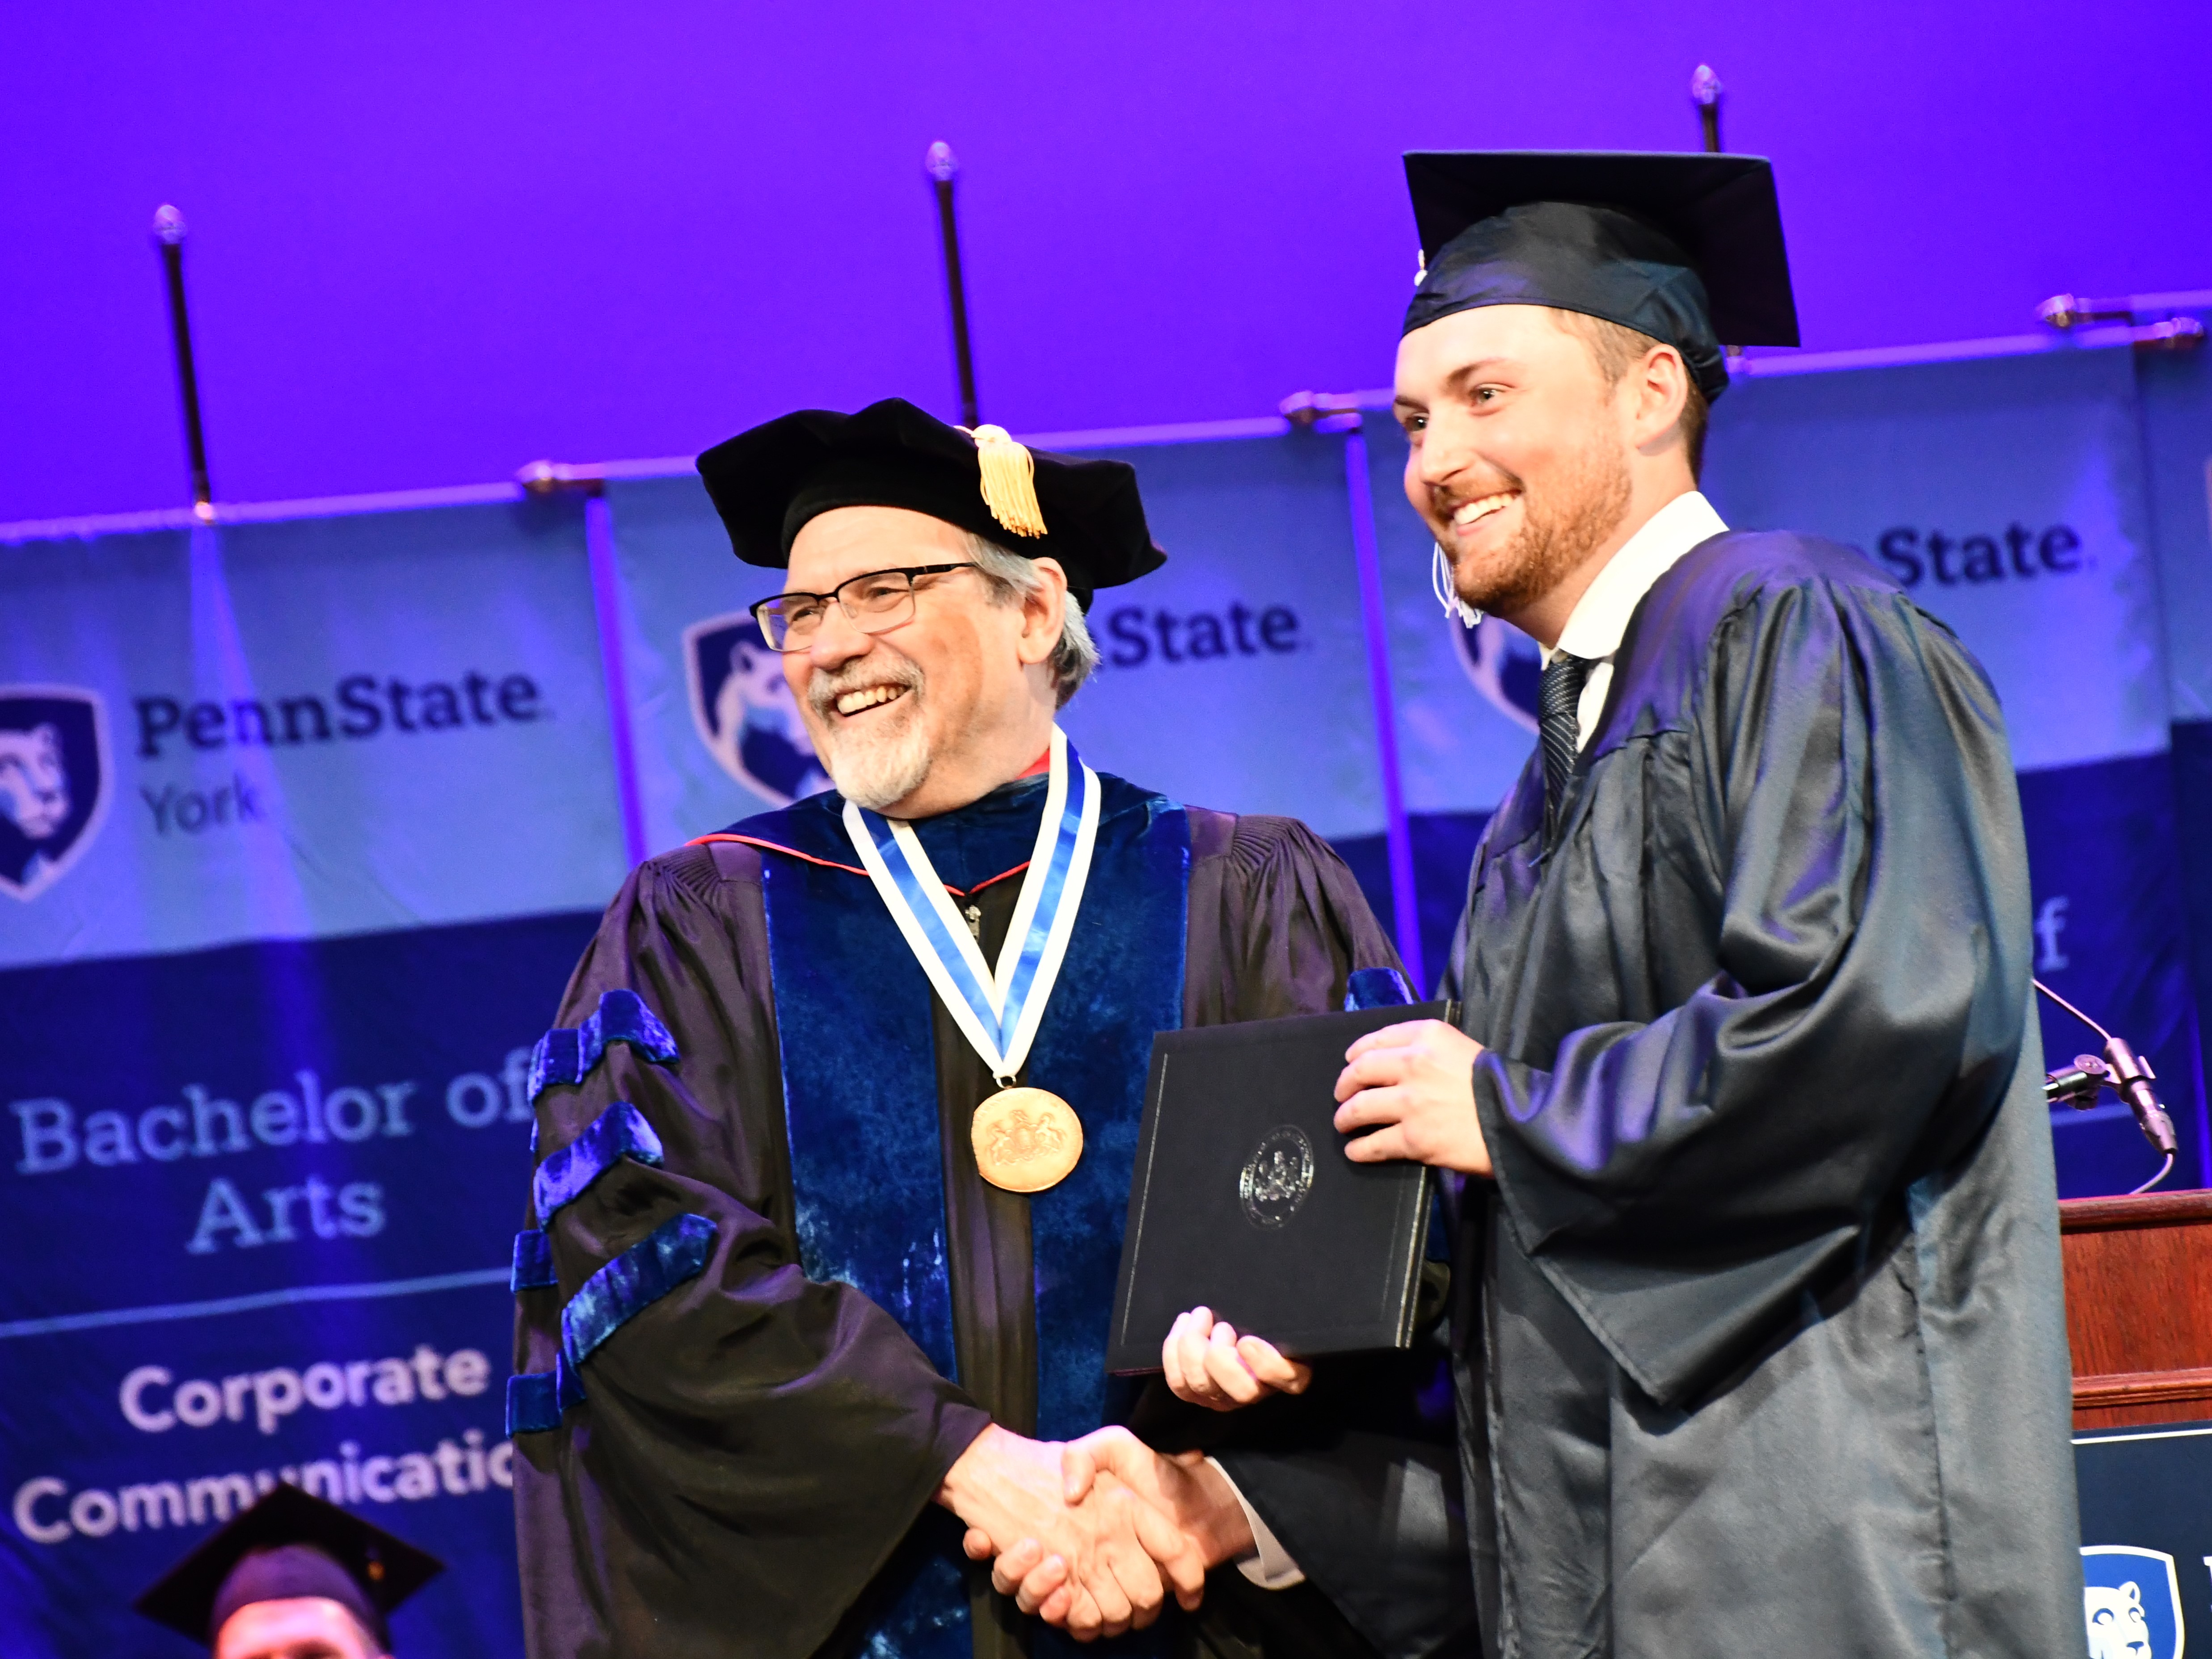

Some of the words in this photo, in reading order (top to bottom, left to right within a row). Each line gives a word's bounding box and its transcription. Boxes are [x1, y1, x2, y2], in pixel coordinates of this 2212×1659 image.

[134, 669, 544, 759] PennState
[140, 772, 263, 835] York
[10, 1069, 417, 1175] Bachelor
[446, 1046, 532, 1128] of
[185, 1173, 387, 1254] Arts
[118, 1343, 491, 1434] Corporate
